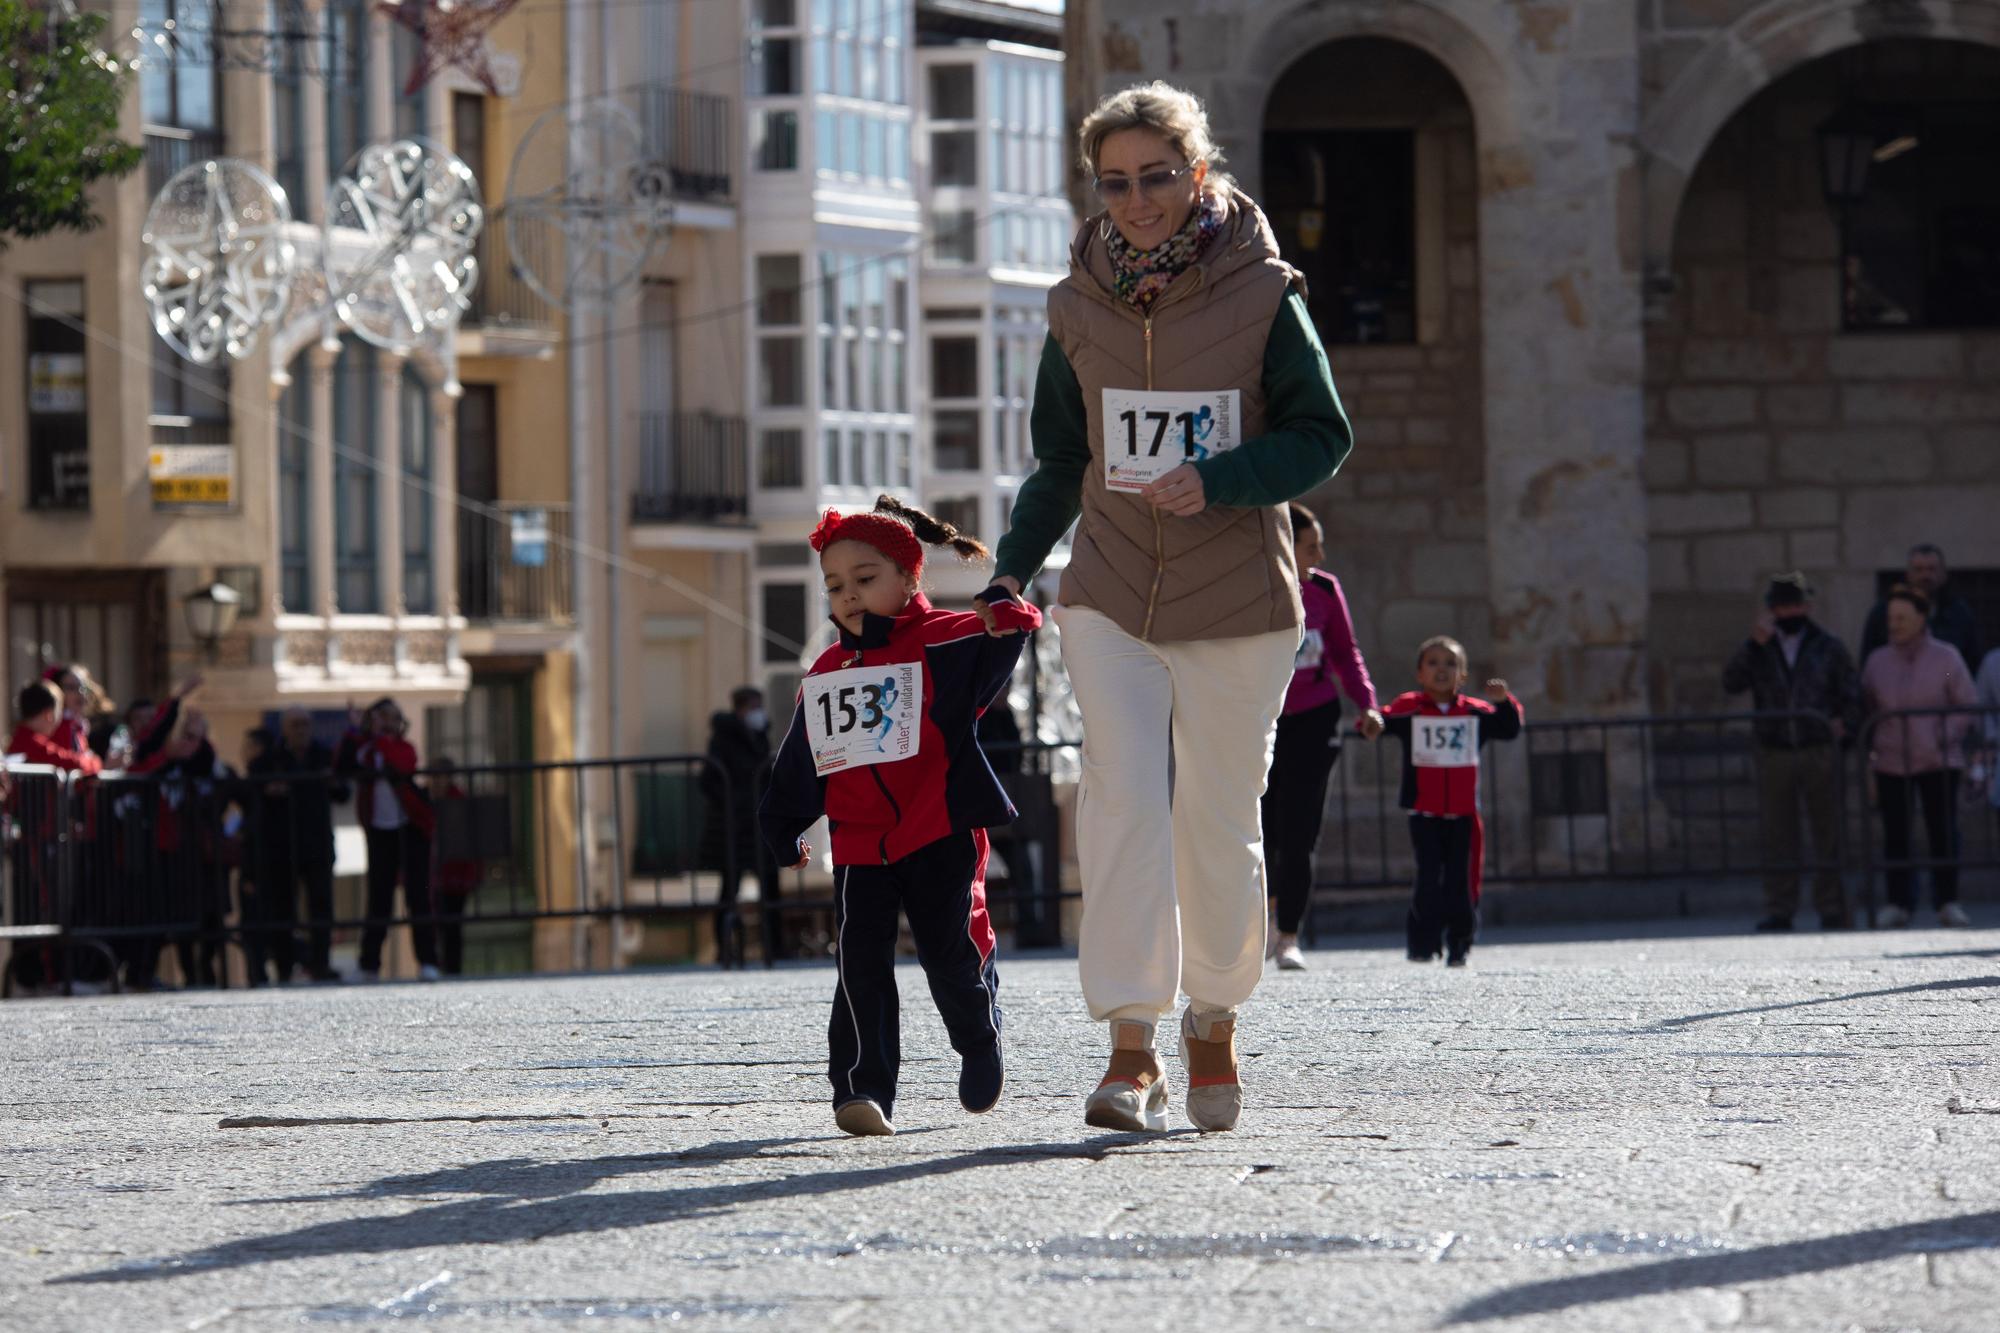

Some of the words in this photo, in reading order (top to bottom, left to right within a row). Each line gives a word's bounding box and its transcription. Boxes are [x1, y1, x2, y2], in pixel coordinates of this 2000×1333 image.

[1120, 410, 1194, 457] 171
[1216, 395, 1229, 440] solidaridad
[900, 667, 913, 709] solidaridad
[817, 684, 883, 737] 153
[897, 725, 910, 754] taller
[1422, 725, 1463, 750] 152
